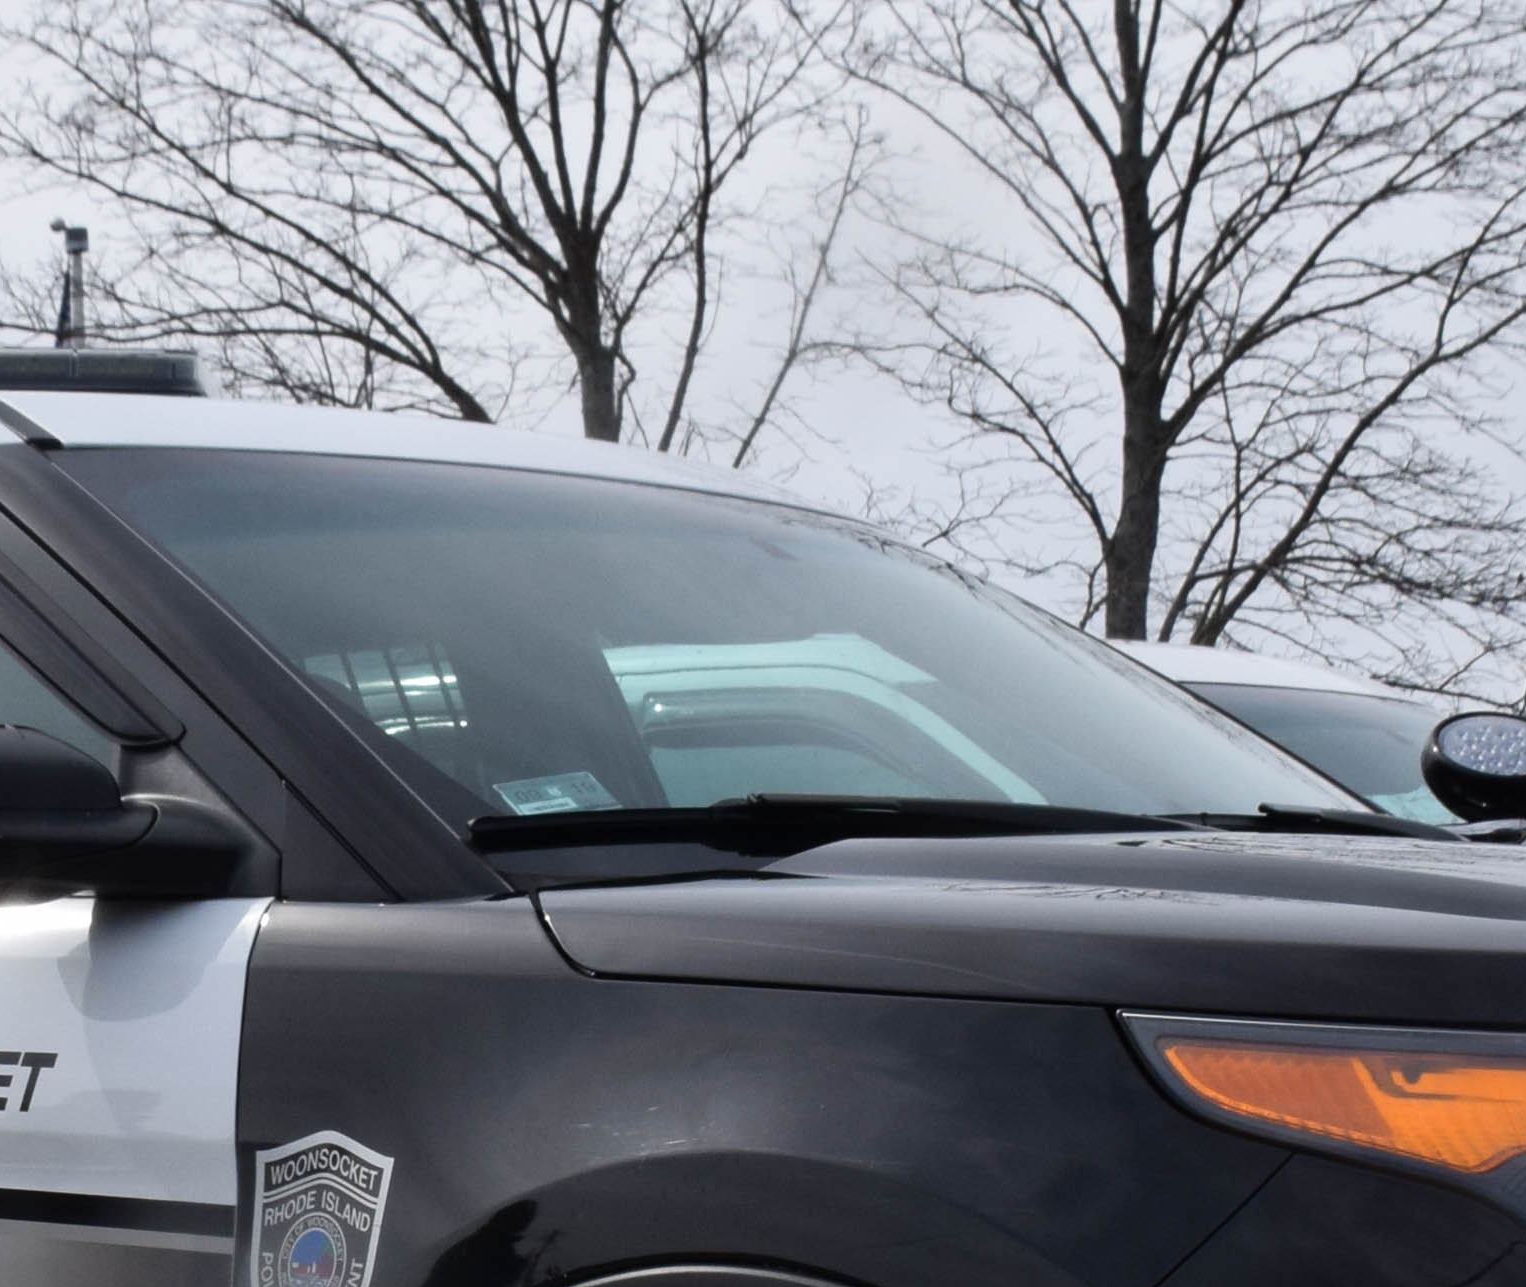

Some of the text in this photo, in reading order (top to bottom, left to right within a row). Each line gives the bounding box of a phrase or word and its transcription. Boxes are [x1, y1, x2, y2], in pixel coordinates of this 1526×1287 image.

[270, 1148, 379, 1190] WOONSOCKET
[263, 1190, 371, 1232] RHODE ISLAND
